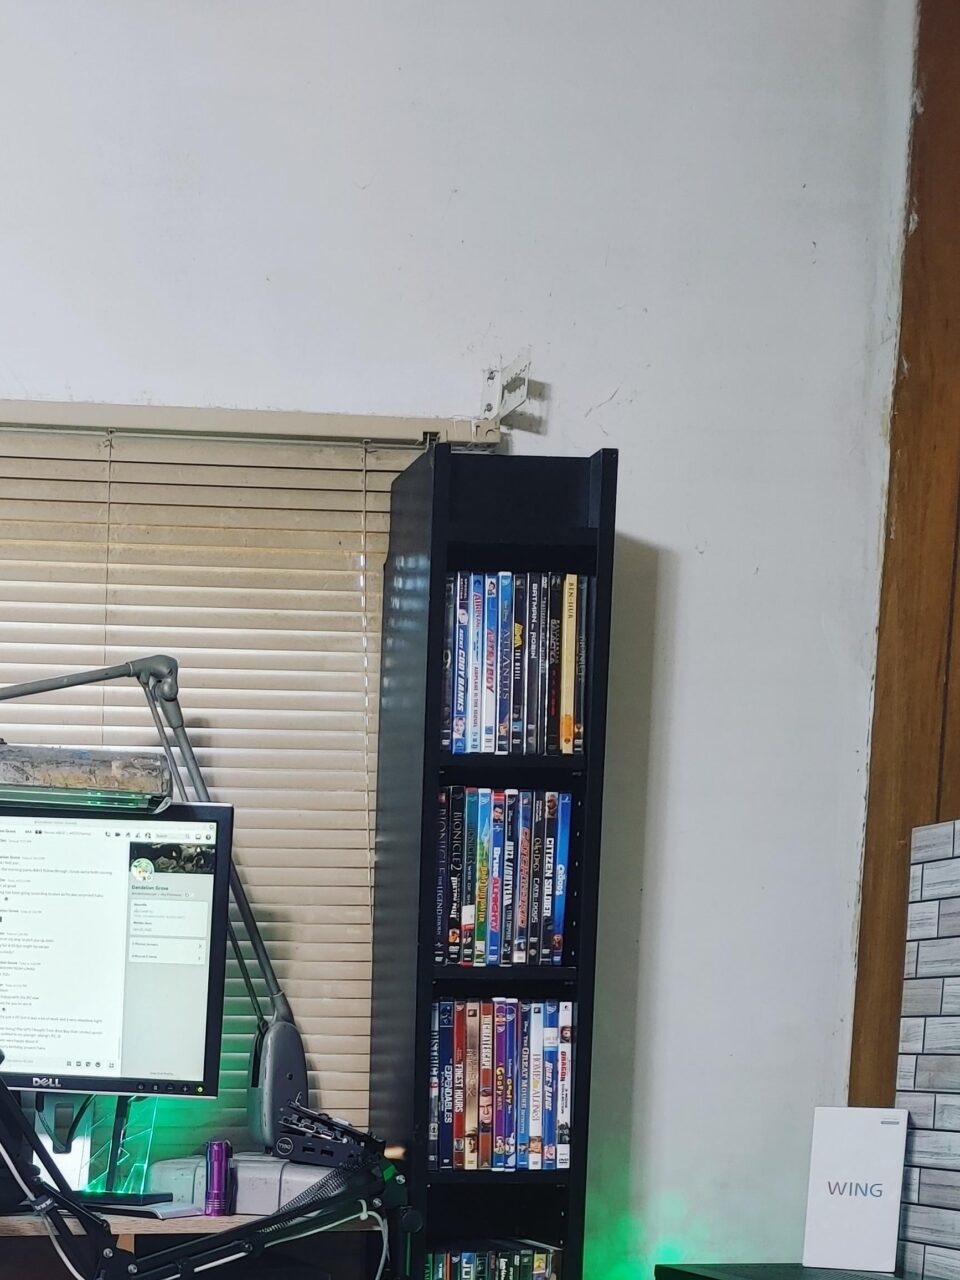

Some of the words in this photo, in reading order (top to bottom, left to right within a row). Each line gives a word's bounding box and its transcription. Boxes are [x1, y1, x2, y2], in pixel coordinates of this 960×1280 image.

[458, 649, 466, 676] CODY
[502, 628, 511, 700] ATLANTIS
[457, 676, 465, 711] BANKS
[453, 811, 462, 862] BIONICLE
[545, 837, 555, 877] CITIZEN
[543, 878, 553, 917] SOLDIER
[455, 1063, 464, 1087] FINEST
[521, 1047, 530, 1078] GREAT
[532, 1053, 541, 1080] HOME
[31, 1076, 62, 1088] DELL
[444, 1065, 453, 1123] EXPENDABLES
[520, 1079, 529, 1109] MOUSE
[455, 1088, 464, 1113] HOURS
[827, 1180, 884, 1198] WING
